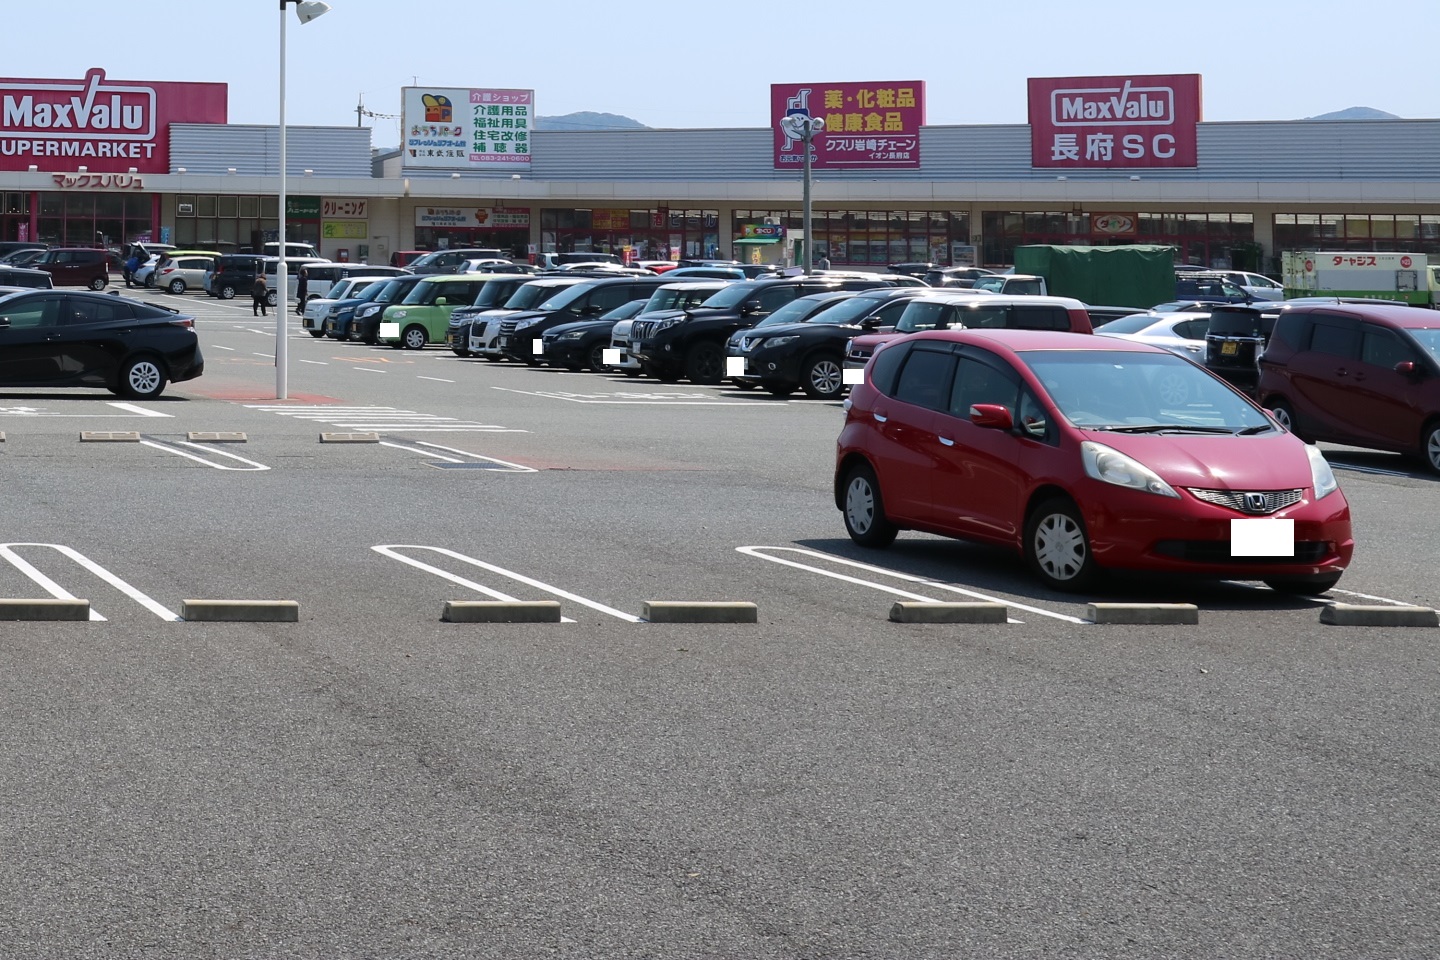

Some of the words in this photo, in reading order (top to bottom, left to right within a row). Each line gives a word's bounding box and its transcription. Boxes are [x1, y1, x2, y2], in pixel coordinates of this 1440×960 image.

[3, 75, 143, 129] MaxValu
[825, 88, 915, 108] 薬・化粧品
[1062, 80, 1164, 119] MaxValu
[473, 105, 527, 116] 介護用品
[473, 117, 527, 129] 福祉用具
[825, 112, 903, 132] 健康食品
[473, 130, 527, 141] 住宅改修
[826, 139, 916, 151] クスリ岩崎チェーン
[53, 174, 144, 189] マックスバリュ
[324, 201, 365, 215] クリーニング
